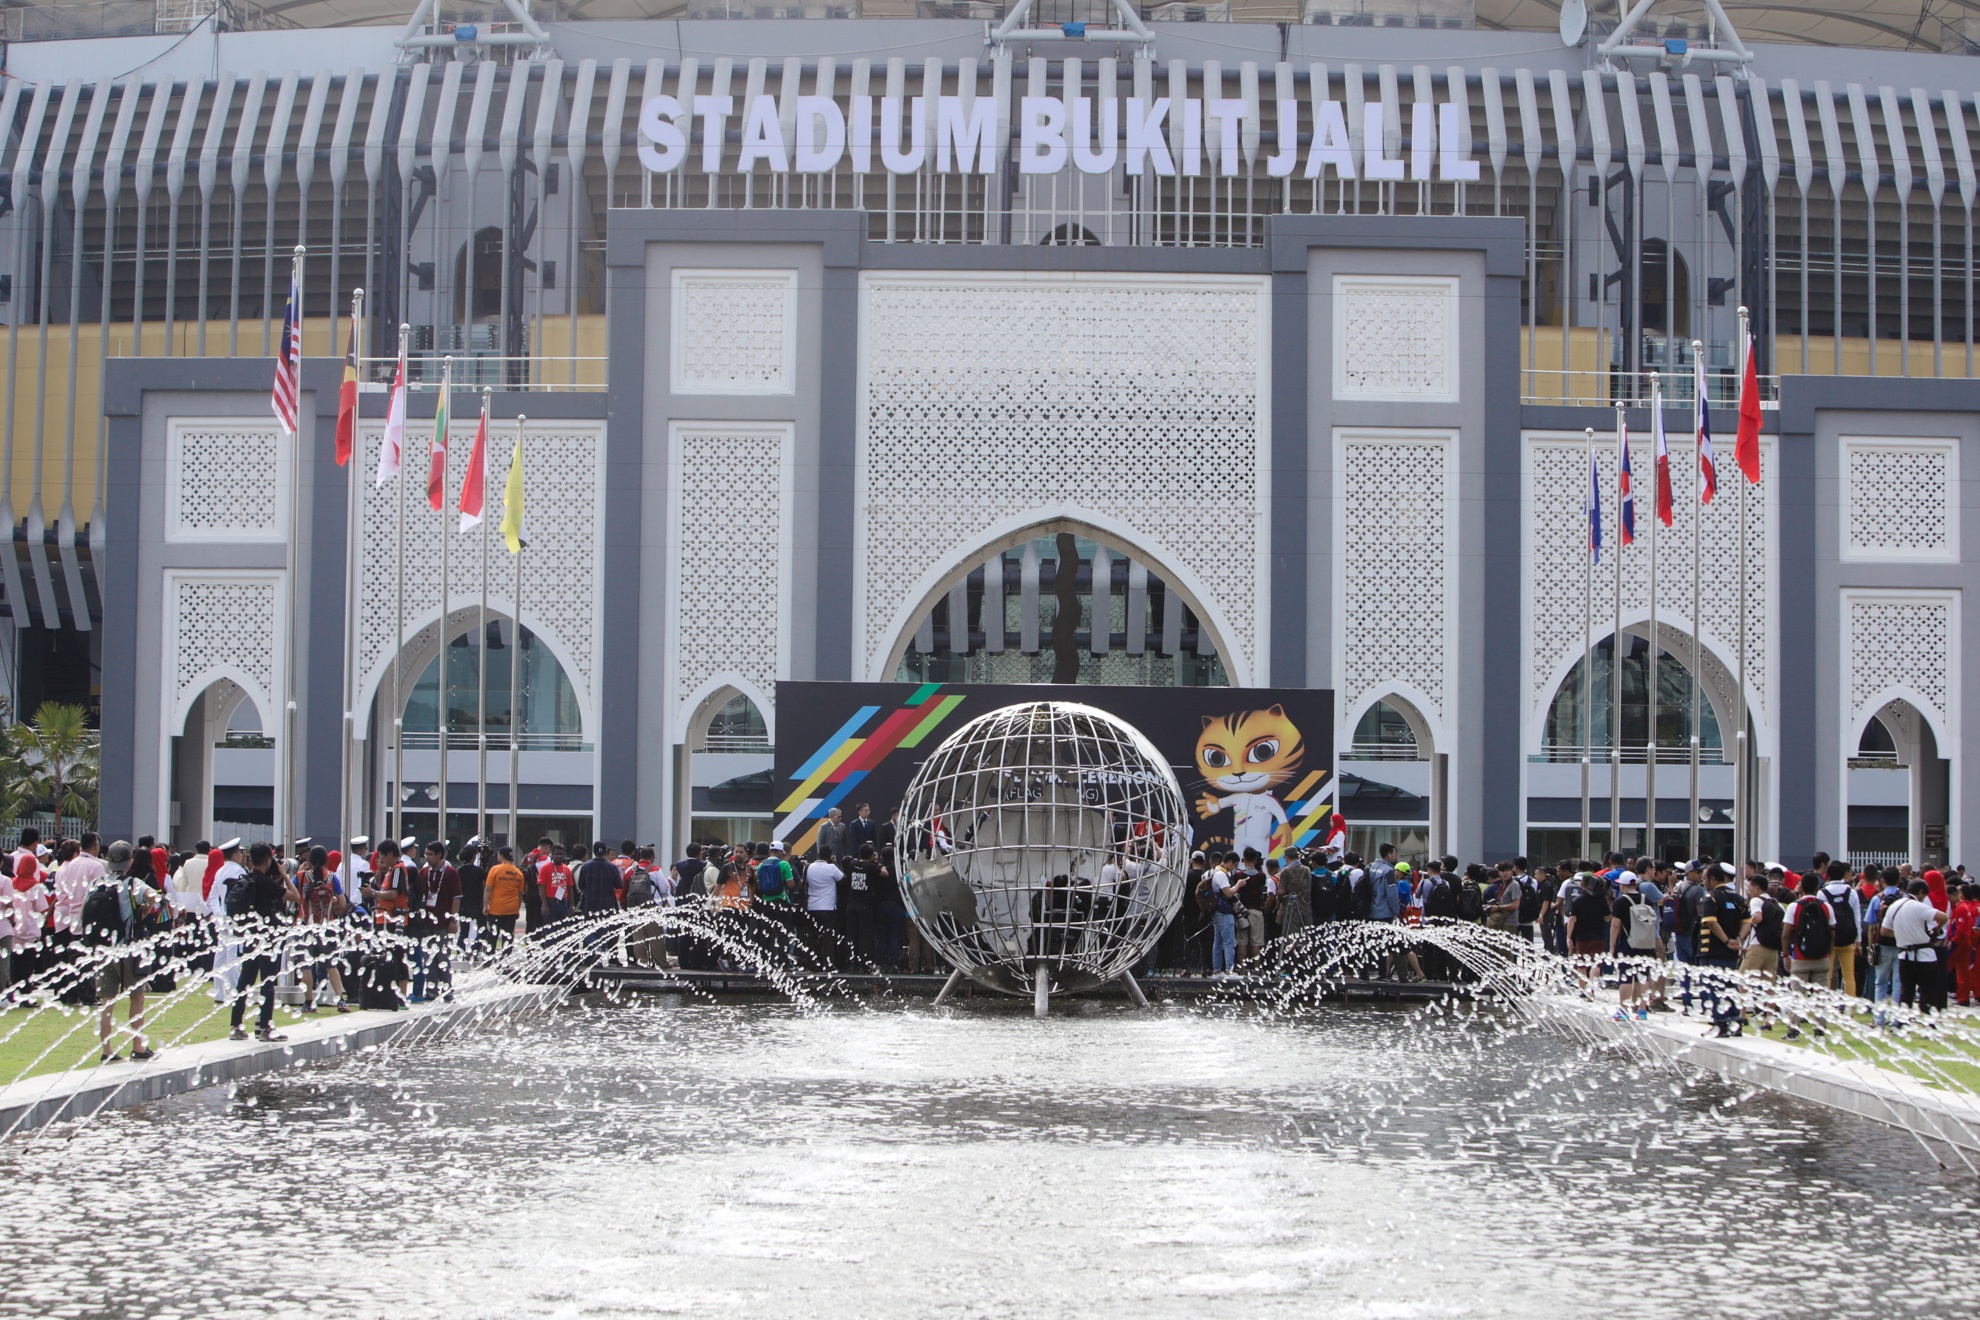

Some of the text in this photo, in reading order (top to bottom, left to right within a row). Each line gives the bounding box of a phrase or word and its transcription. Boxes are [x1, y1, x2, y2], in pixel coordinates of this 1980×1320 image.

[637, 95, 1480, 181] STADIUM BUKIT JALIL
